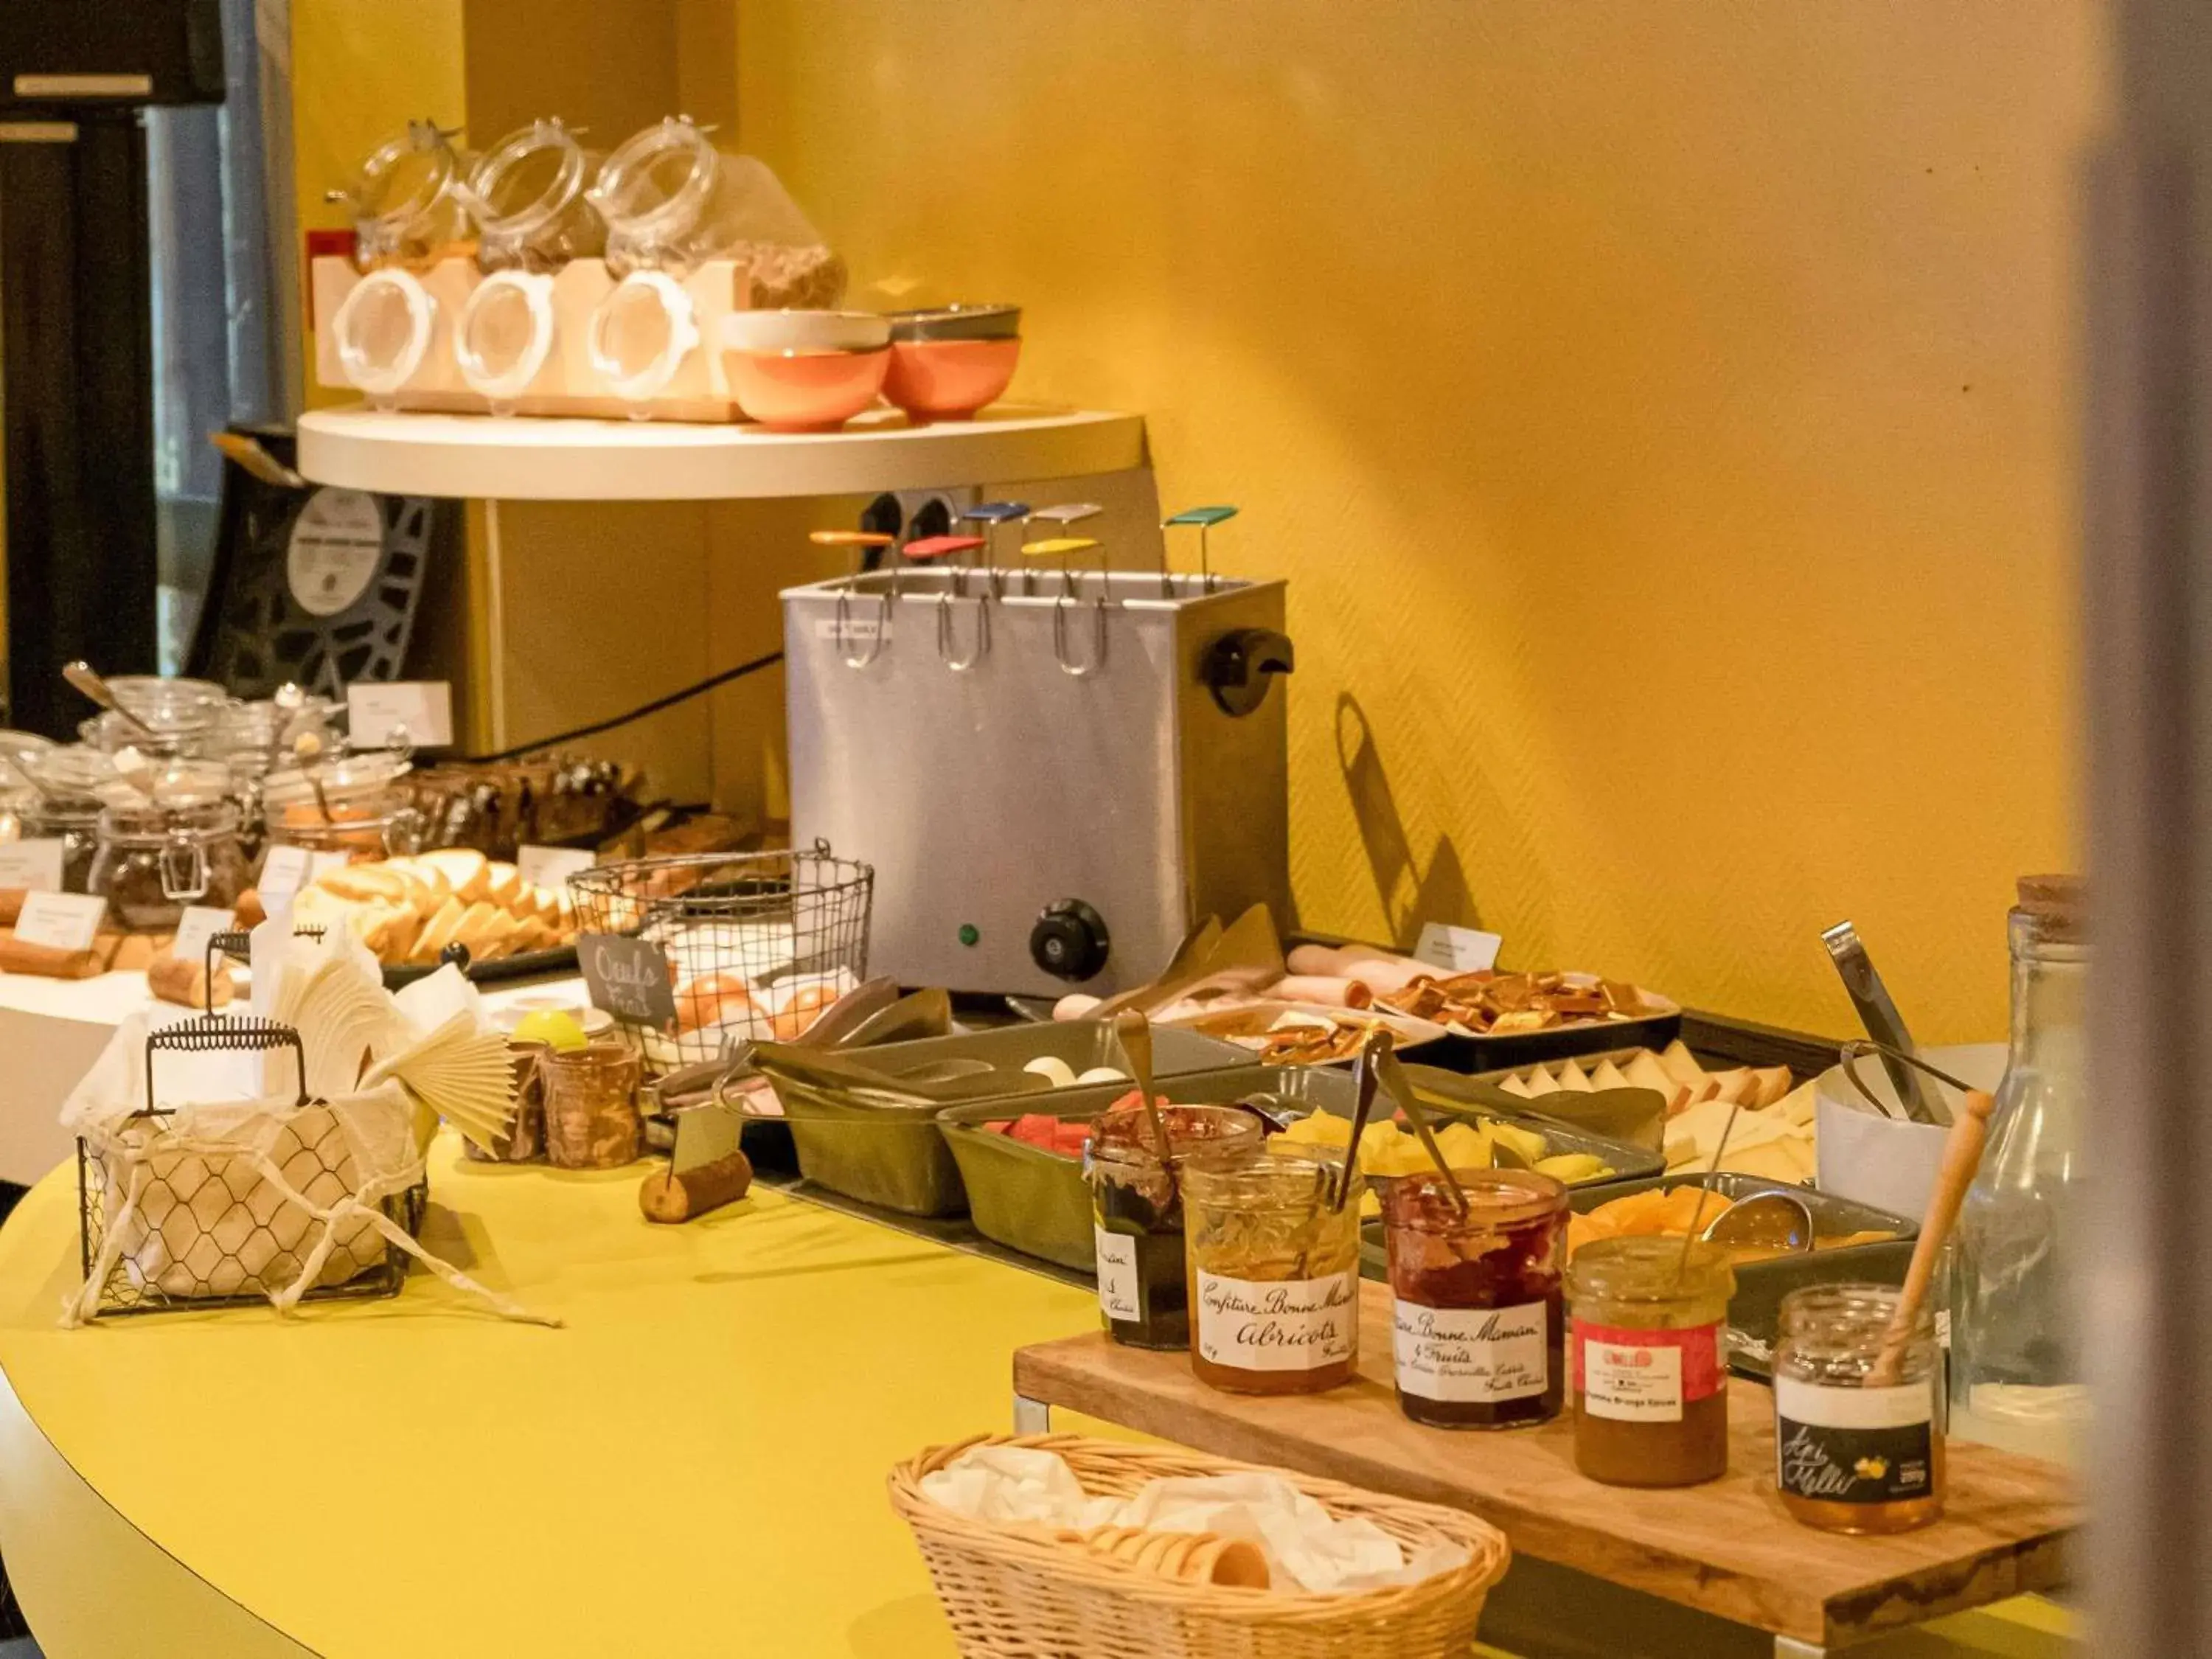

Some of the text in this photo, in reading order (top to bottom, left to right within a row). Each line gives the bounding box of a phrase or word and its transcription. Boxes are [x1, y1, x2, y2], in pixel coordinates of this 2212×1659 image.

[1264, 1288, 1319, 1315] Bonne
[1413, 1312, 1468, 1342] Bonne
[1470, 1312, 1539, 1342] Maman
